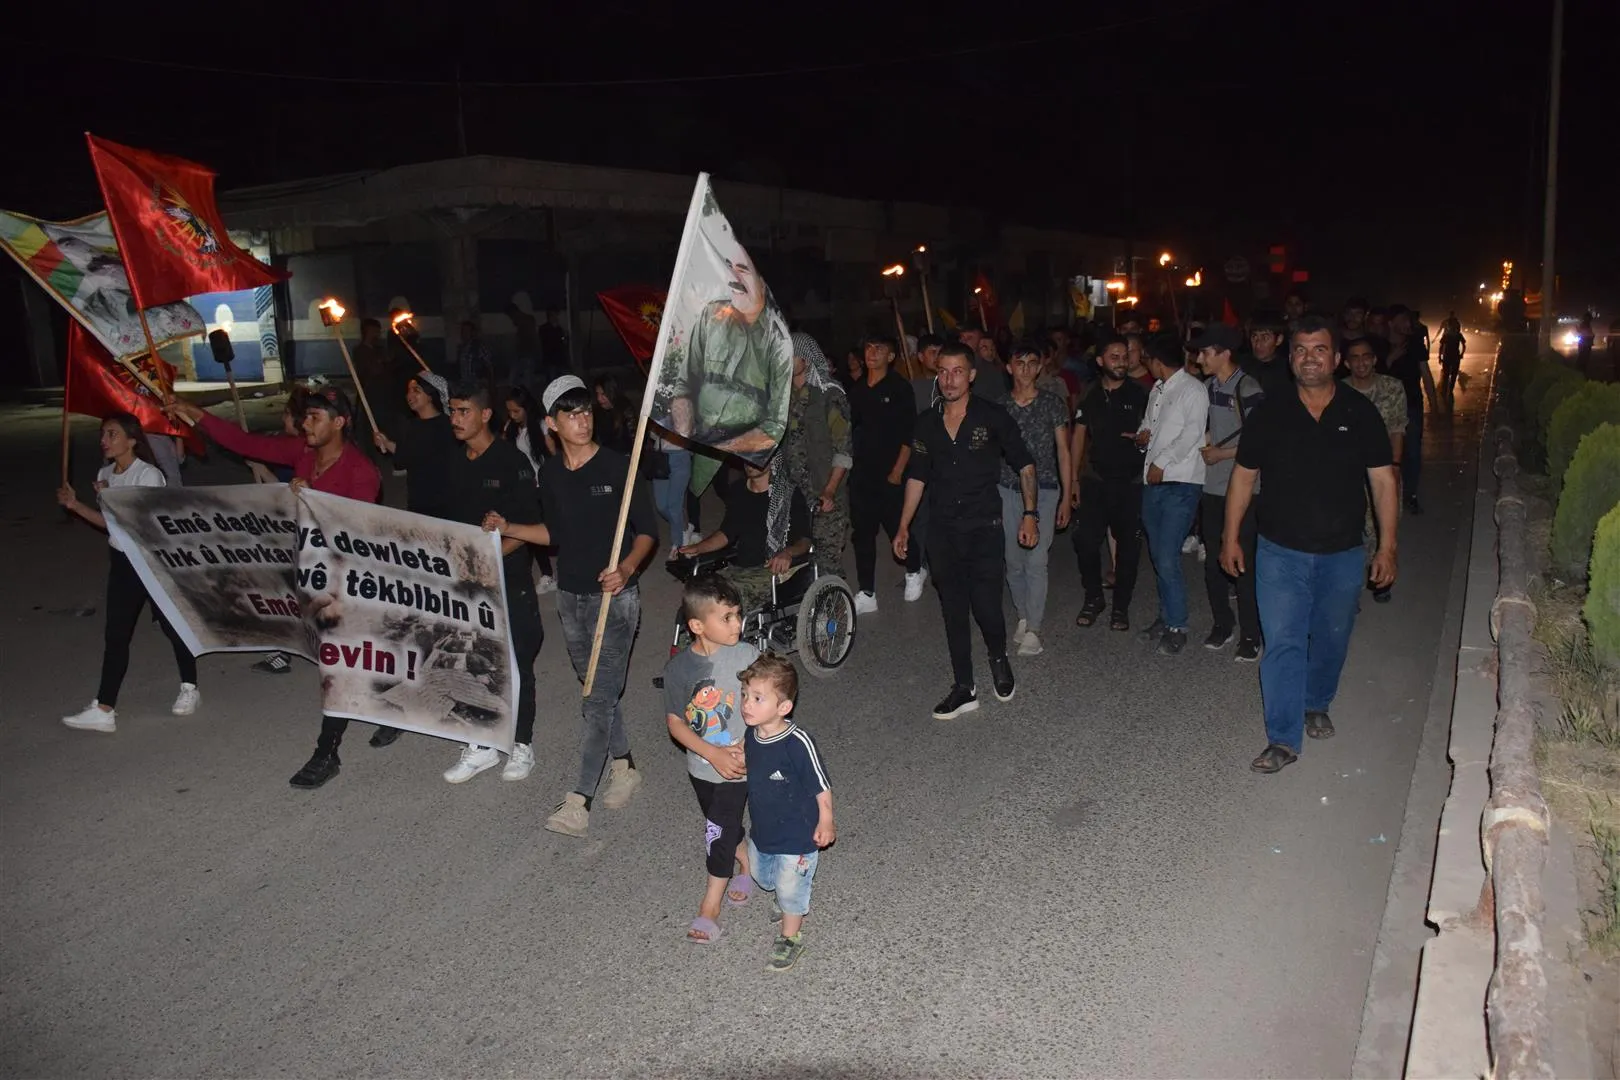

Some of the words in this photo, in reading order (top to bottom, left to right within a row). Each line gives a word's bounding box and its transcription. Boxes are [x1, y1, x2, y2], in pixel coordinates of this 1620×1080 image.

[157, 512, 212, 536] Emê
[199, 544, 220, 564] û
[334, 531, 451, 577] dewleta
[346, 569, 470, 622] têkbibin
[478, 601, 495, 631] û
[320, 641, 395, 675] evin
